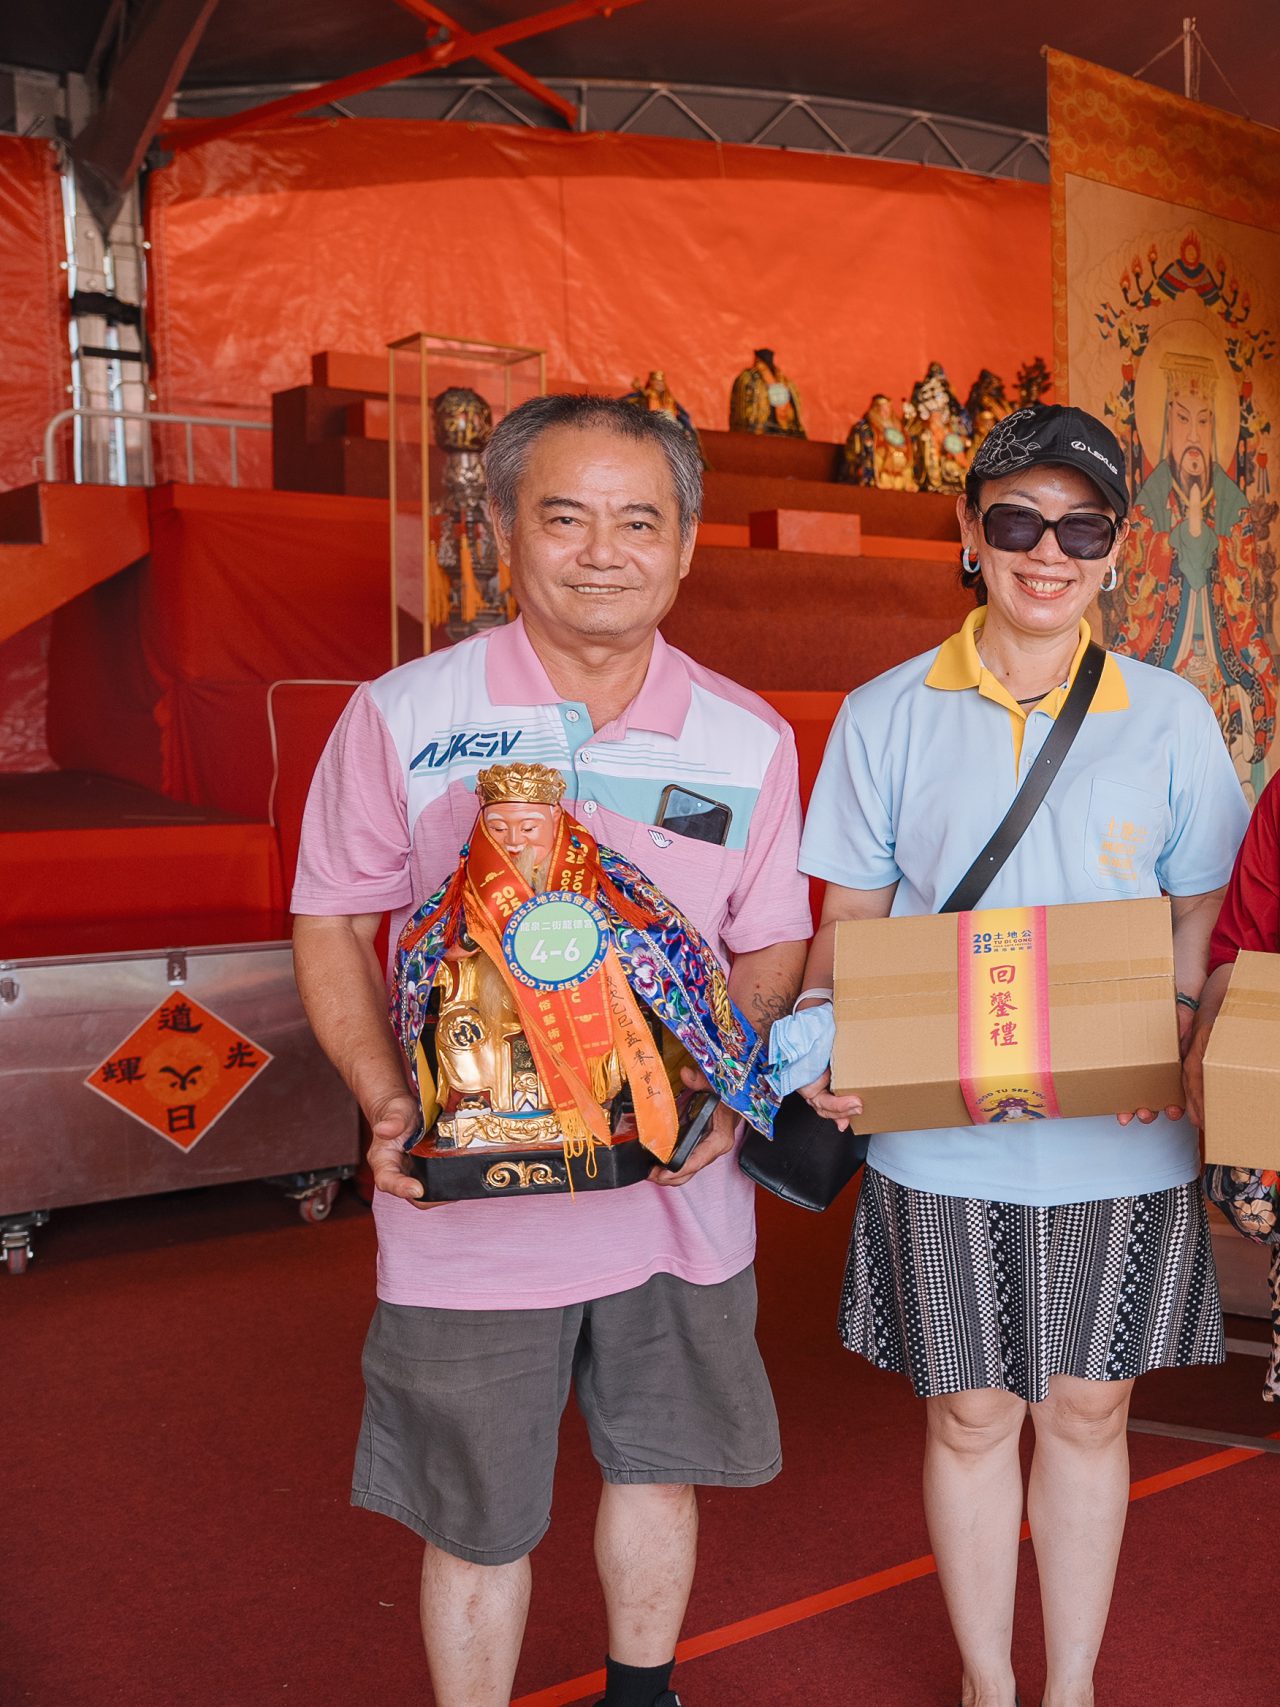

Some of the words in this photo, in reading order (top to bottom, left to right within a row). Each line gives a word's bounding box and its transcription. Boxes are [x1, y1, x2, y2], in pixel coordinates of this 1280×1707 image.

[1087, 446, 1118, 475] LEXUS
[491, 885, 516, 905] 20
[499, 897, 523, 917] 25
[973, 933, 992, 943] 20
[994, 930, 1032, 940] 土地公
[530, 937, 580, 964] 4-6
[973, 944, 992, 954] 25
[509, 962, 536, 987] GOOD
[538, 982, 554, 992] TU
[557, 978, 580, 991] SEE
[580, 959, 602, 980] YOU
[158, 1003, 203, 1033] 道
[224, 1042, 258, 1069] 光
[102, 1056, 146, 1084] 輝
[167, 1104, 196, 1133] 日
